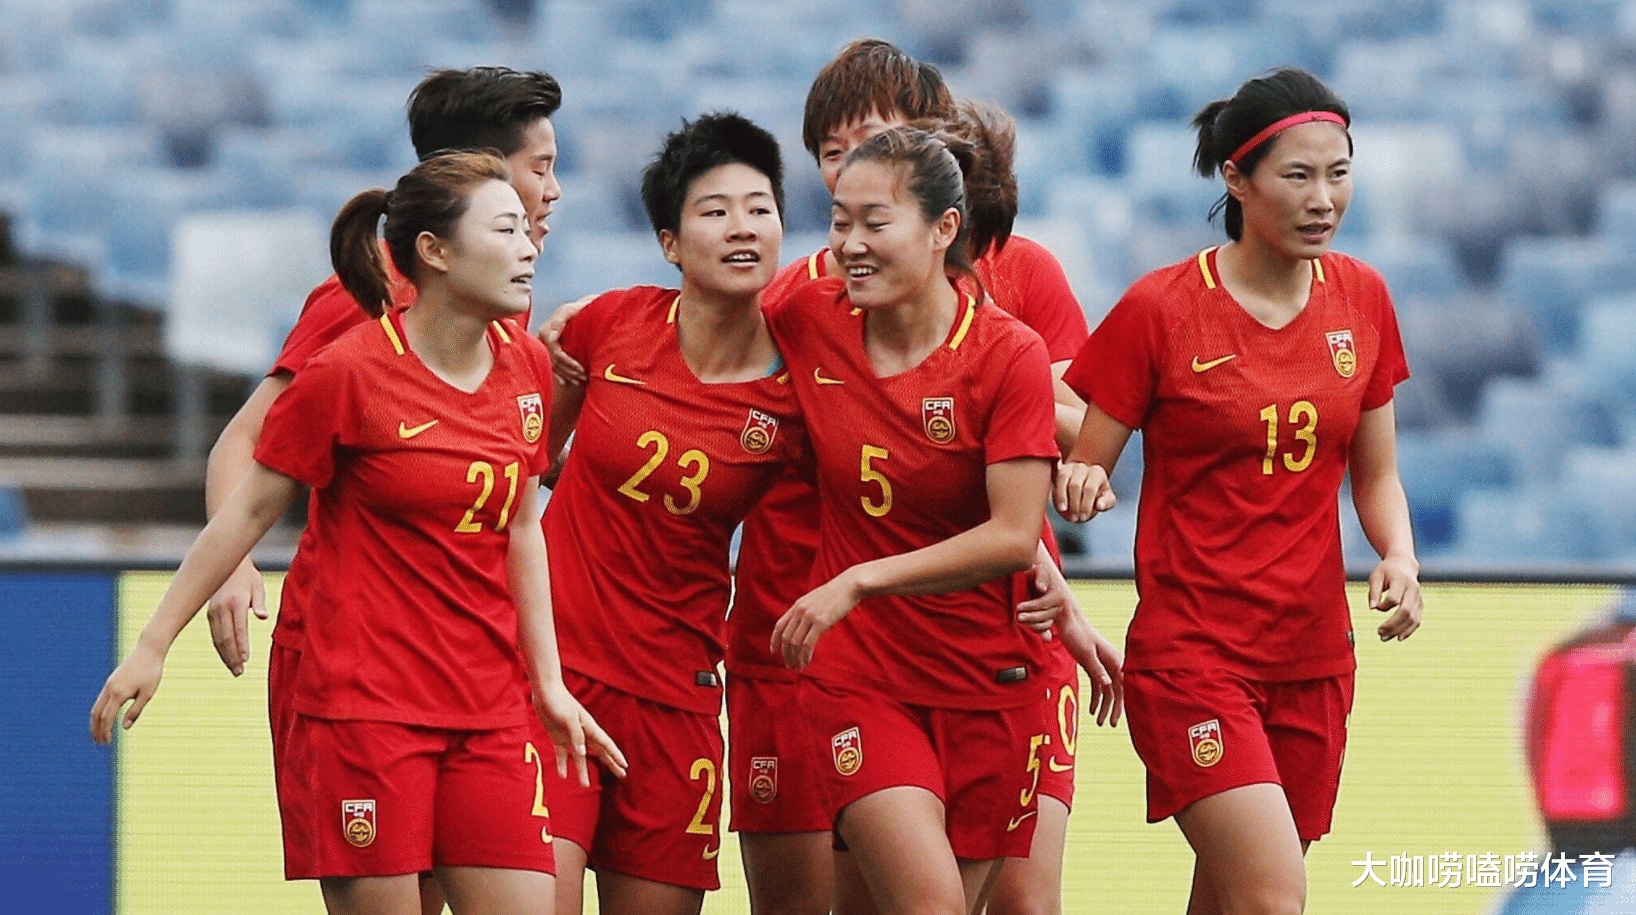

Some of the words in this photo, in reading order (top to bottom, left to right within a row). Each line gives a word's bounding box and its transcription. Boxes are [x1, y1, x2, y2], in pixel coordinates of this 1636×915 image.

[752, 410, 776, 427] CFA
[925, 401, 951, 410] CFA
[1260, 400, 1318, 475] 13
[617, 430, 709, 515] 23
[860, 444, 893, 517] 5
[454, 461, 519, 532] 21
[834, 731, 857, 747] CFA
[1191, 722, 1217, 738] CFA
[753, 760, 775, 769] CFA
[1020, 734, 1043, 807] 5
[345, 803, 373, 813] CFA
[685, 758, 724, 835] 2
